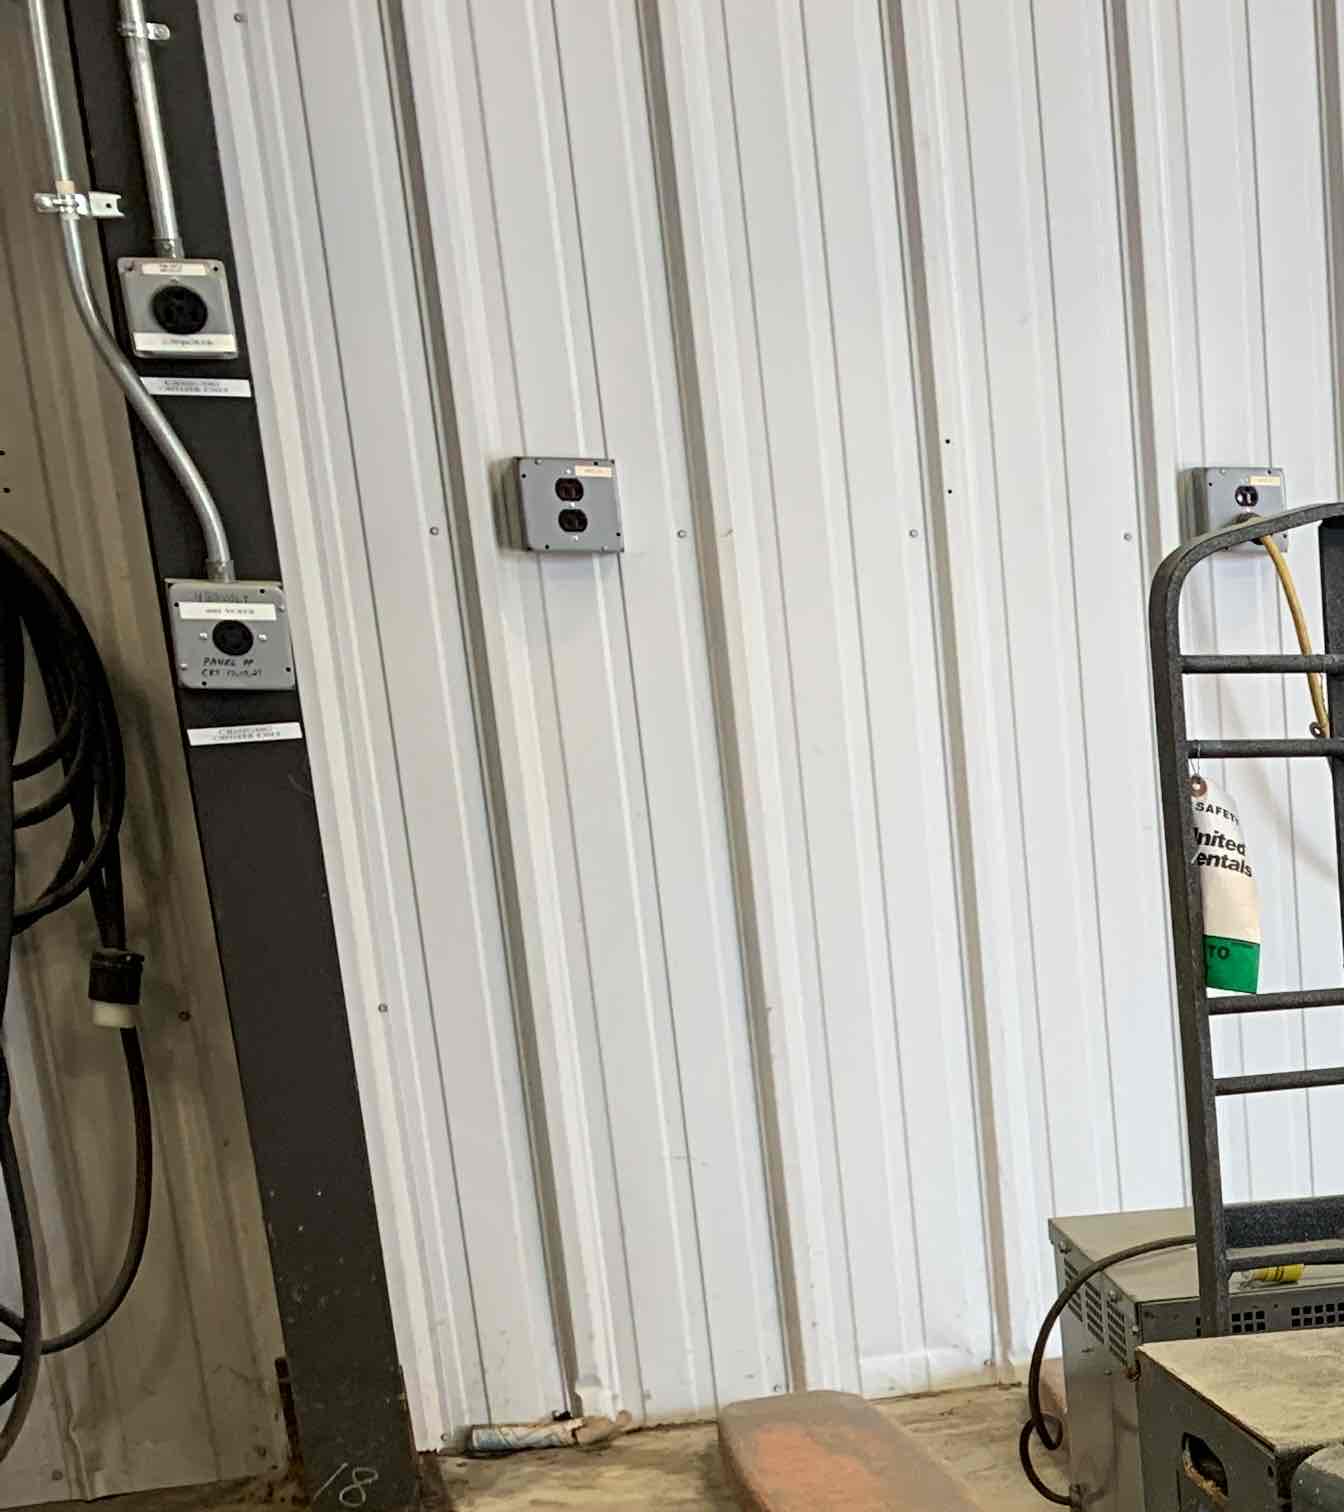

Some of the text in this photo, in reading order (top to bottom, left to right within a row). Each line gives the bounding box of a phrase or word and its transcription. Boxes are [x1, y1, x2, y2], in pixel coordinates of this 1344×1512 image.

[1195, 801, 1241, 827] SAFETY
[1197, 851, 1253, 878] entals
[312, 1461, 379, 1508] 18
